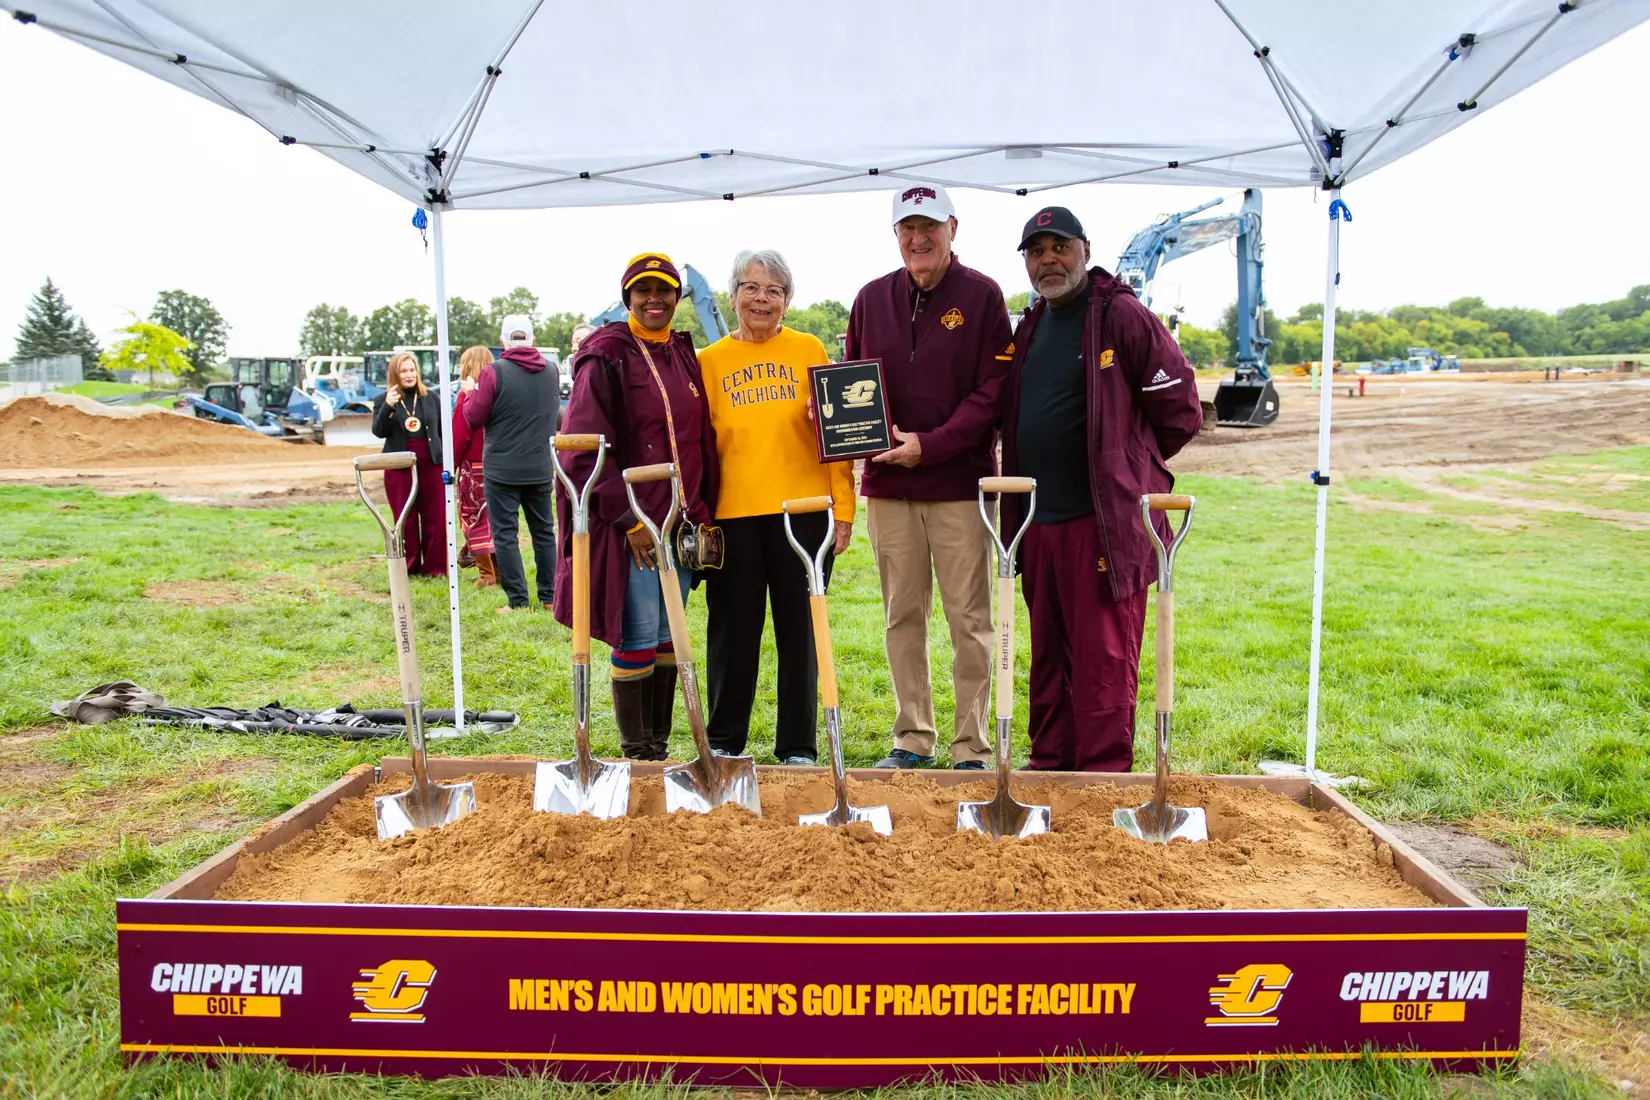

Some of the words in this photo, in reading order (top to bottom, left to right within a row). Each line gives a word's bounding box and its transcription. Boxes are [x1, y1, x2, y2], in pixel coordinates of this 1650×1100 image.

[1037, 212, 1053, 227] C
[722, 362, 799, 393] CENTRAL
[731, 384, 796, 407] MICHIGAN
[399, 614, 410, 655] TRUPER
[150, 963, 303, 996] CHIPPEWA
[351, 960, 438, 1014] C
[1207, 964, 1293, 1017] C
[1339, 970, 1490, 1001] CHIPPEWA
[206, 996, 248, 1015] GOLF
[509, 979, 594, 1012] MEN'S
[597, 980, 657, 1013] AND
[661, 982, 798, 1016] WOMEN'S
[802, 983, 872, 1017] GOLF
[875, 983, 1013, 1016] PRACTICE
[1017, 983, 1137, 1015] FACILITY
[1393, 1003, 1433, 1022] GOLF
